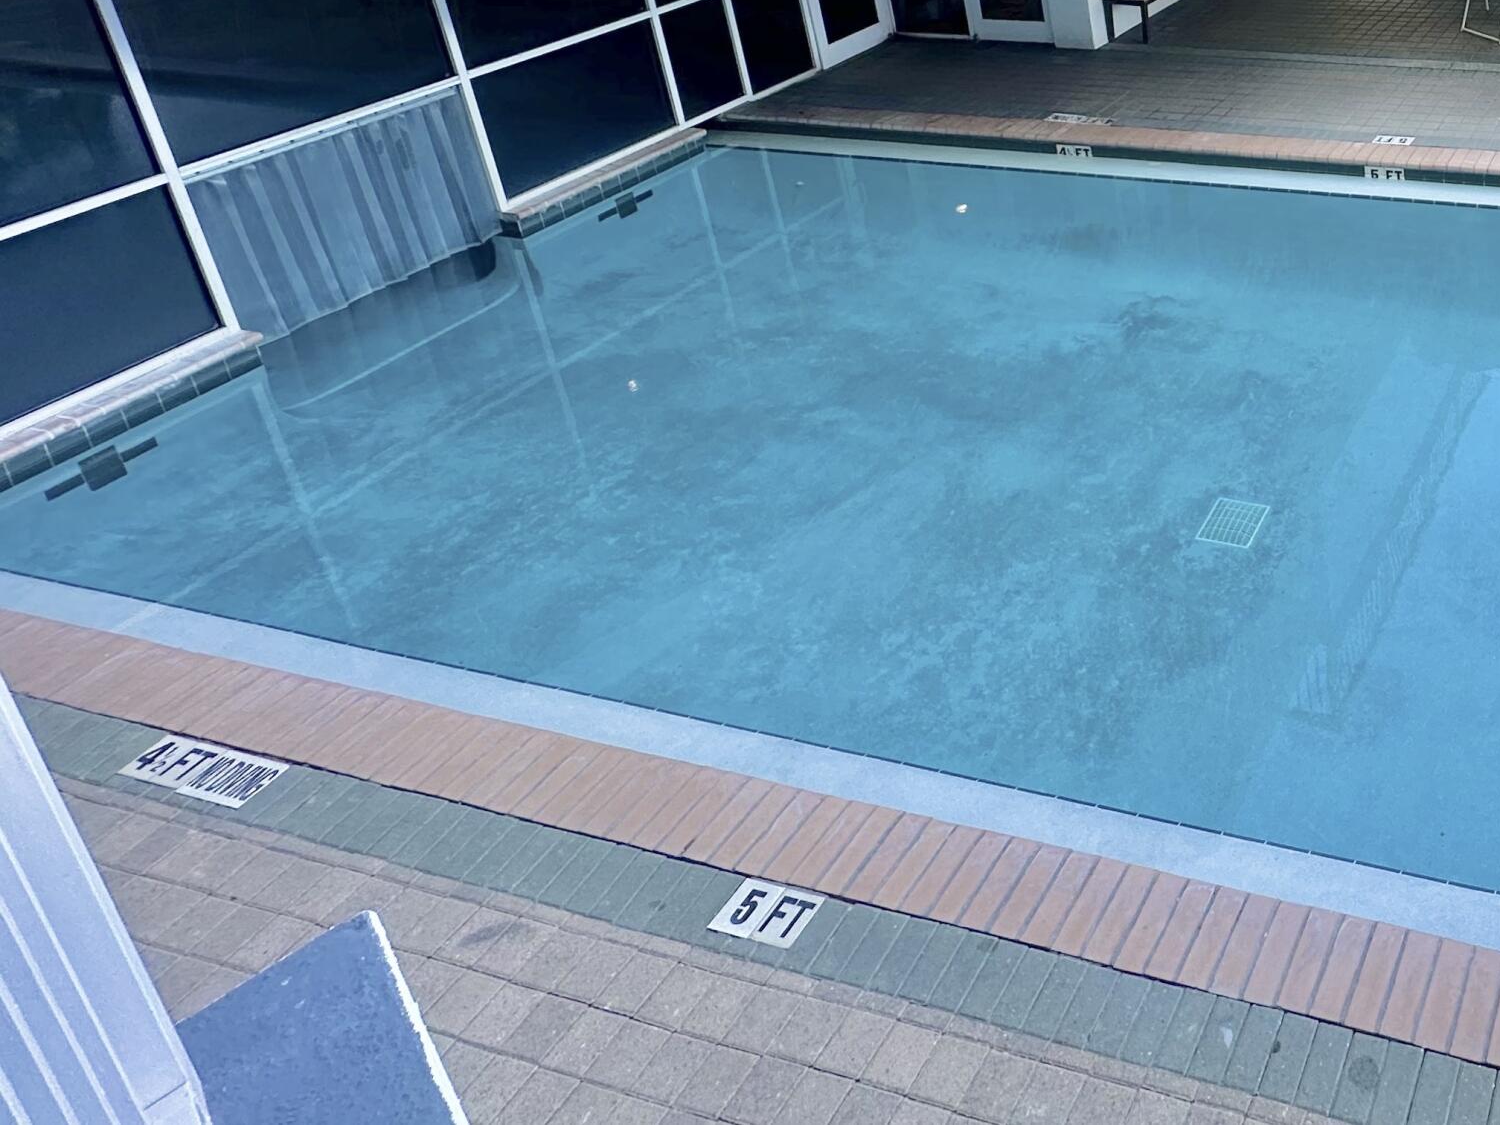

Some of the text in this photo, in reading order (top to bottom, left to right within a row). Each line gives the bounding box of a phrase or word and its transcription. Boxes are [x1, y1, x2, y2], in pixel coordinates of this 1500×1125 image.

[1075, 147, 1090, 157] FT
[1386, 170, 1402, 180] FT
[158, 747, 218, 781] FT
[730, 888, 817, 939] 5 FT
